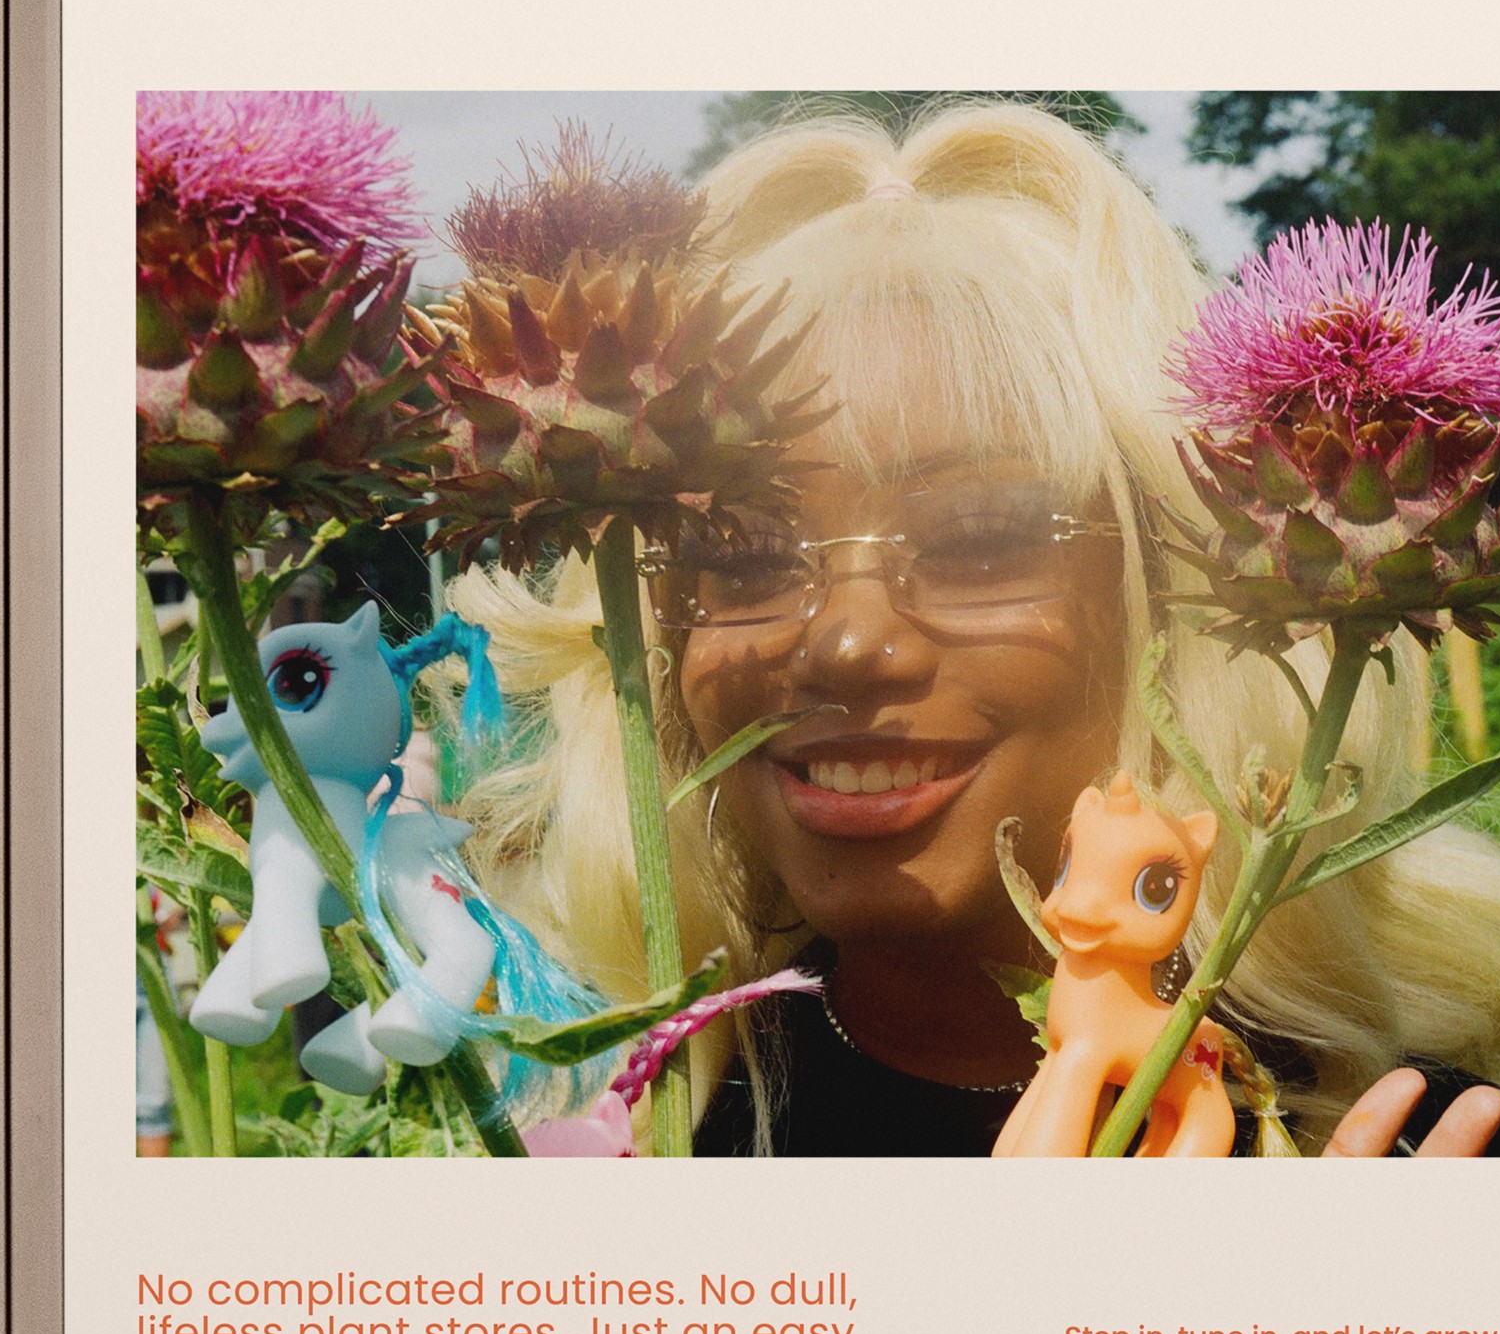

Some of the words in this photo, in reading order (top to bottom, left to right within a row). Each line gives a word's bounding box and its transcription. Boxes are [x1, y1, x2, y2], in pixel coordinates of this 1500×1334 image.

[139, 1274, 193, 1306] No
[208, 1272, 484, 1315] complicated
[501, 1272, 685, 1306] routines.
[702, 1274, 756, 1306] No
[771, 1272, 857, 1311] dull,
